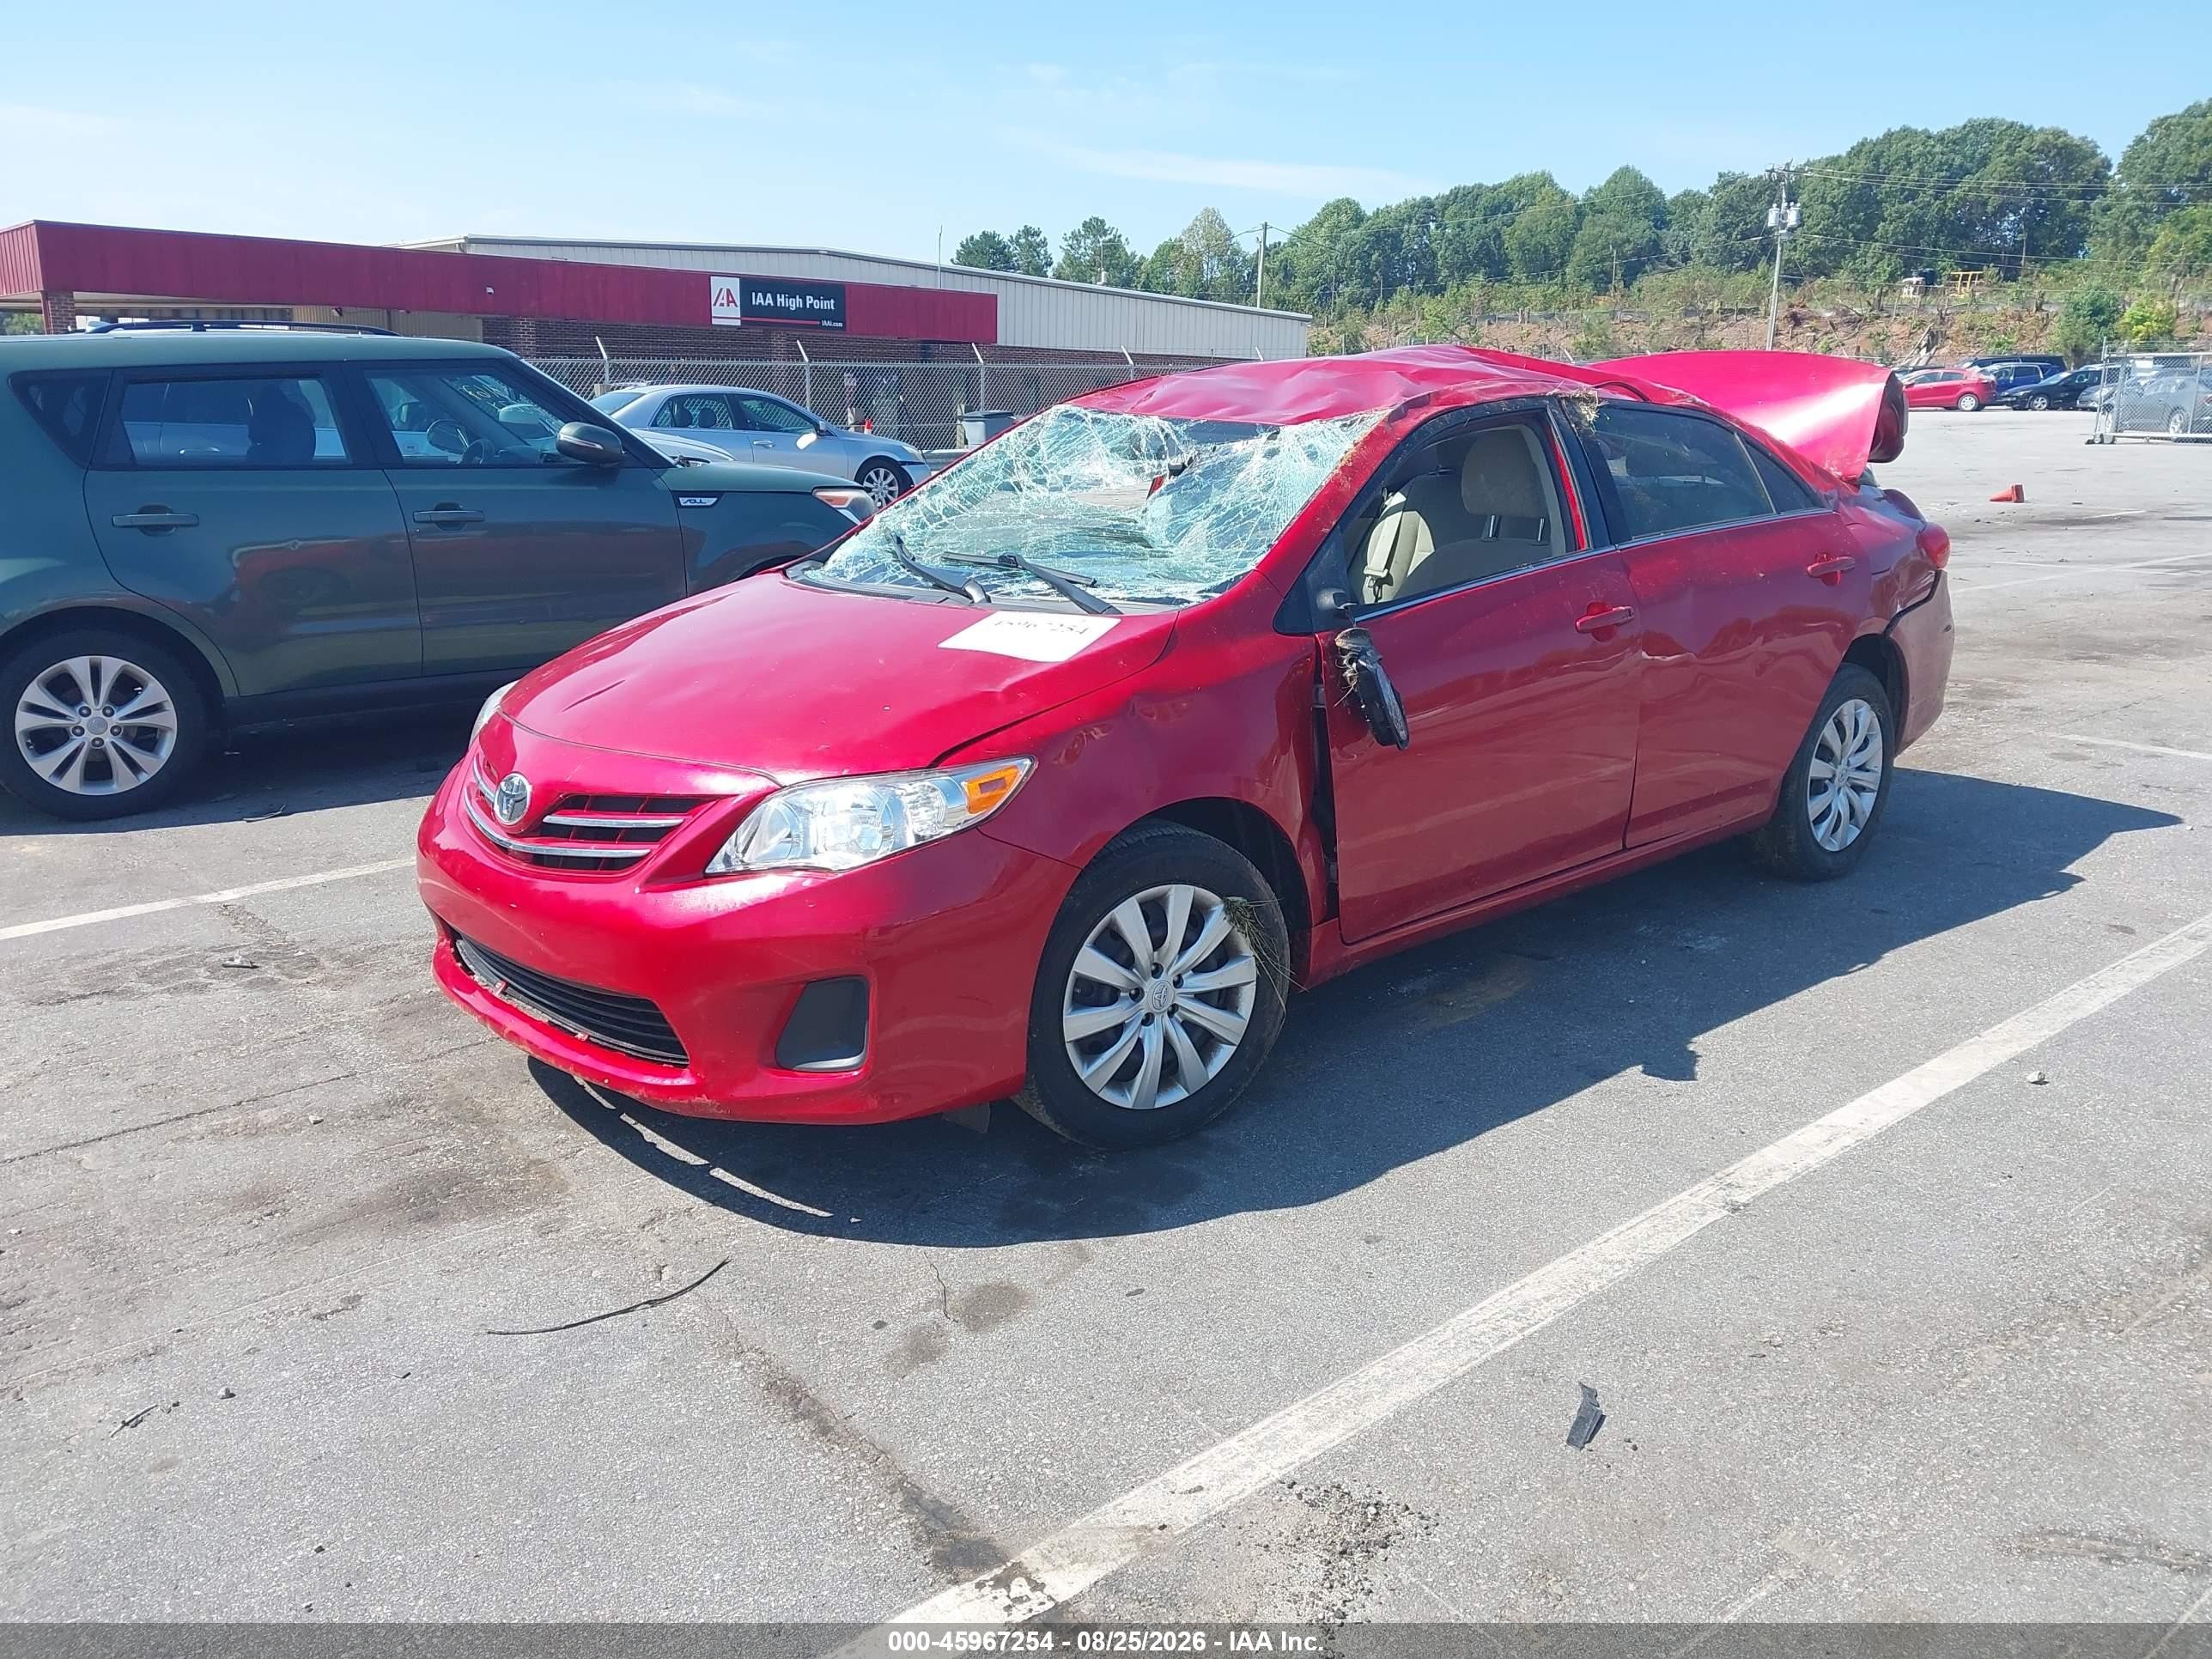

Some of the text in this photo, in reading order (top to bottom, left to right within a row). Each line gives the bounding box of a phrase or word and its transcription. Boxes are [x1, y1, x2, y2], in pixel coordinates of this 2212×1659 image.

[752, 292, 835, 311] IAA High Point
